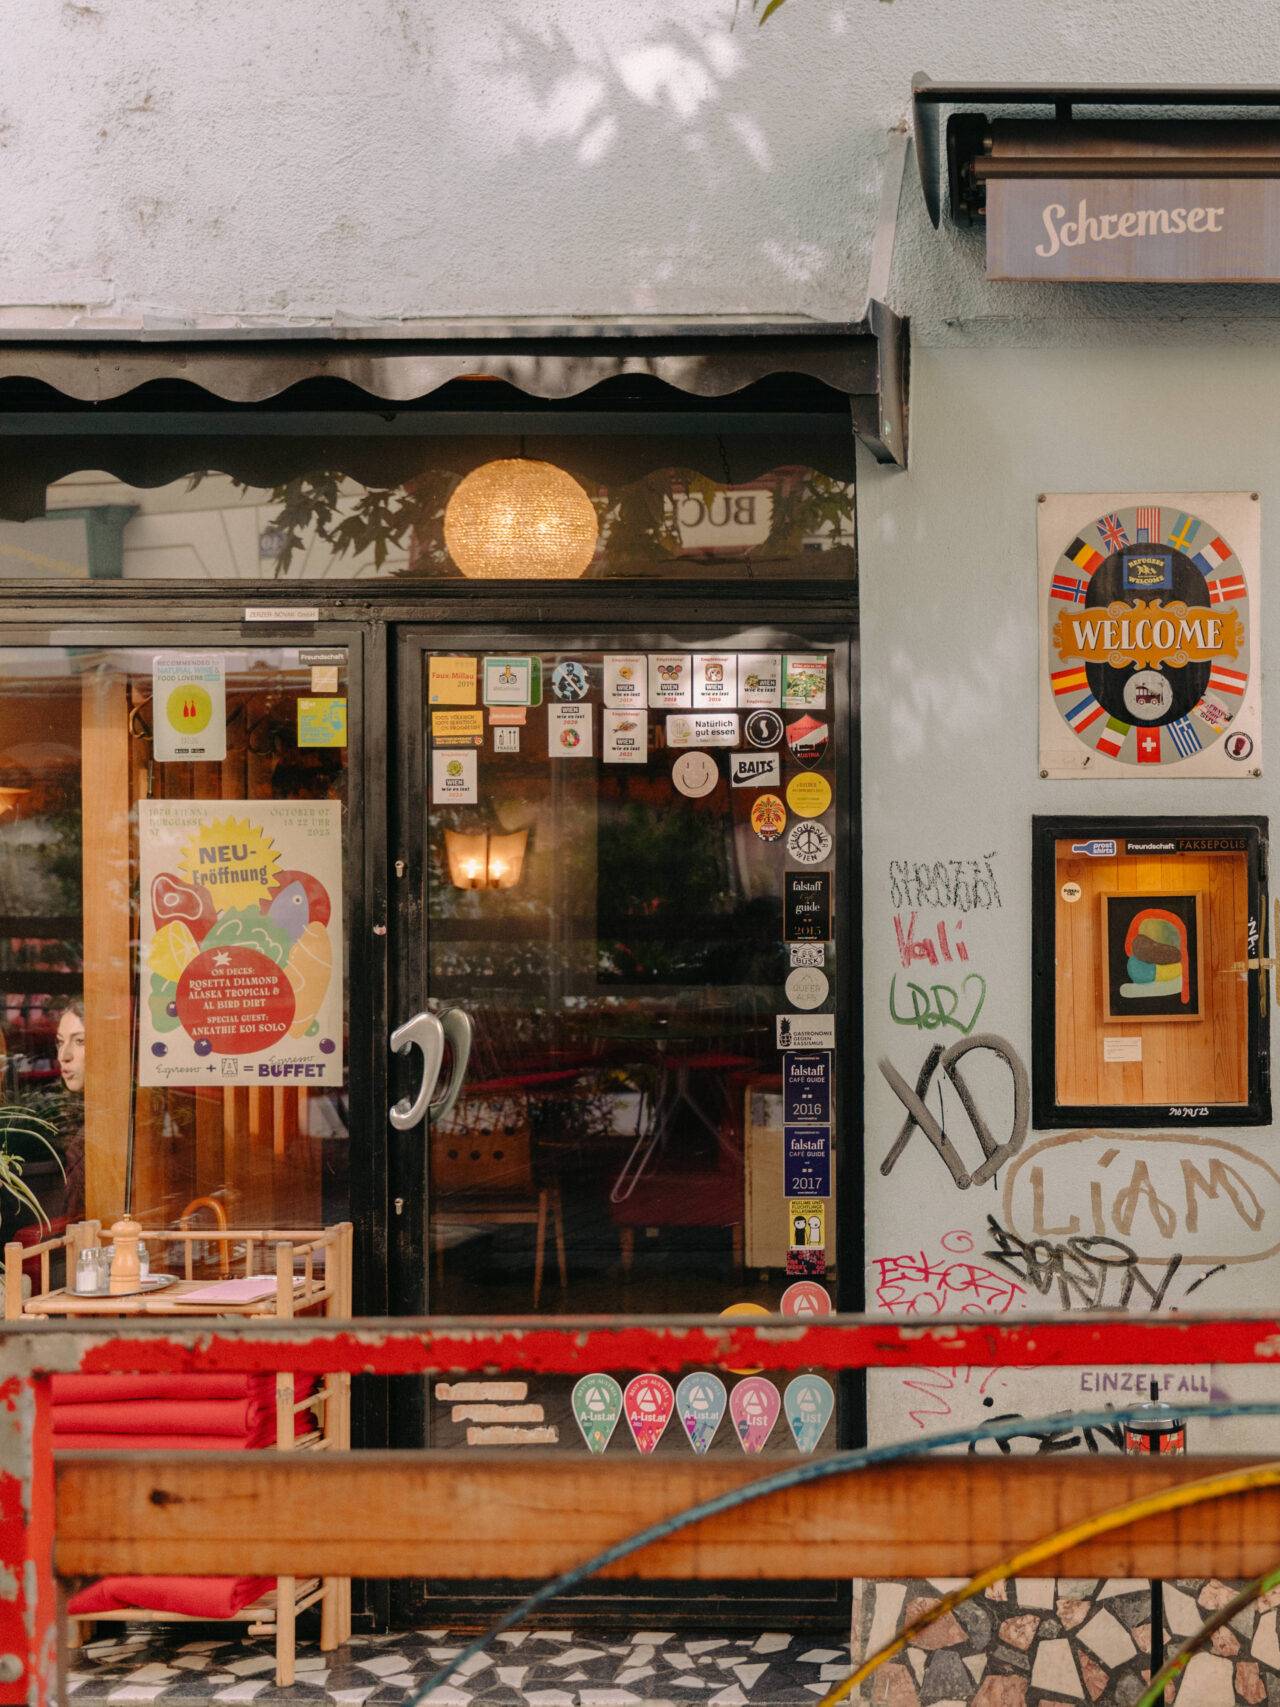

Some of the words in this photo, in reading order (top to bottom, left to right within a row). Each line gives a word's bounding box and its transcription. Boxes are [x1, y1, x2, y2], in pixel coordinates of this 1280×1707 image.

[1035, 199, 1224, 258] Schremser
[1128, 557, 1165, 568] REFUGEES
[1128, 575, 1165, 584] WELCOME
[1071, 619, 1225, 651] WELCOME
[300, 653, 344, 661] Freundschaft
[695, 720, 733, 728] Natürlich
[695, 729, 709, 737] gut
[739, 760, 774, 774] BAITS
[270, 808, 315, 816] OCTOBER
[1093, 842, 1113, 850] prost
[1179, 839, 1246, 849] FAKSEPOLIS
[199, 844, 257, 864] NEU-
[796, 851, 818, 862] WIEN
[192, 864, 269, 886] Eröffnung
[792, 880, 823, 891] falstaff
[795, 901, 821, 914] guide
[211, 968, 224, 976] ON
[189, 979, 231, 990] ROSETTA
[233, 976, 279, 986] DIAMOND
[188, 991, 223, 1000] ALASKA
[225, 988, 271, 998] TROPICAL
[203, 1002, 215, 1010] AL
[217, 1001, 240, 1009] BIRD
[242, 999, 267, 1008] DIRT
[207, 1015, 239, 1023] SPECIAL
[240, 1014, 269, 1022] GUEST:
[191, 1026, 237, 1036] ANKATHIE
[239, 1024, 257, 1033] KOI
[258, 1022, 286, 1032] SOLO
[155, 1063, 202, 1079] Espresso
[258, 1063, 326, 1078] BUFFET
[791, 1064, 825, 1076] falstaff
[792, 1103, 822, 1115] 2016
[791, 1138, 825, 1150] falstaff
[792, 1177, 822, 1190] 2017
